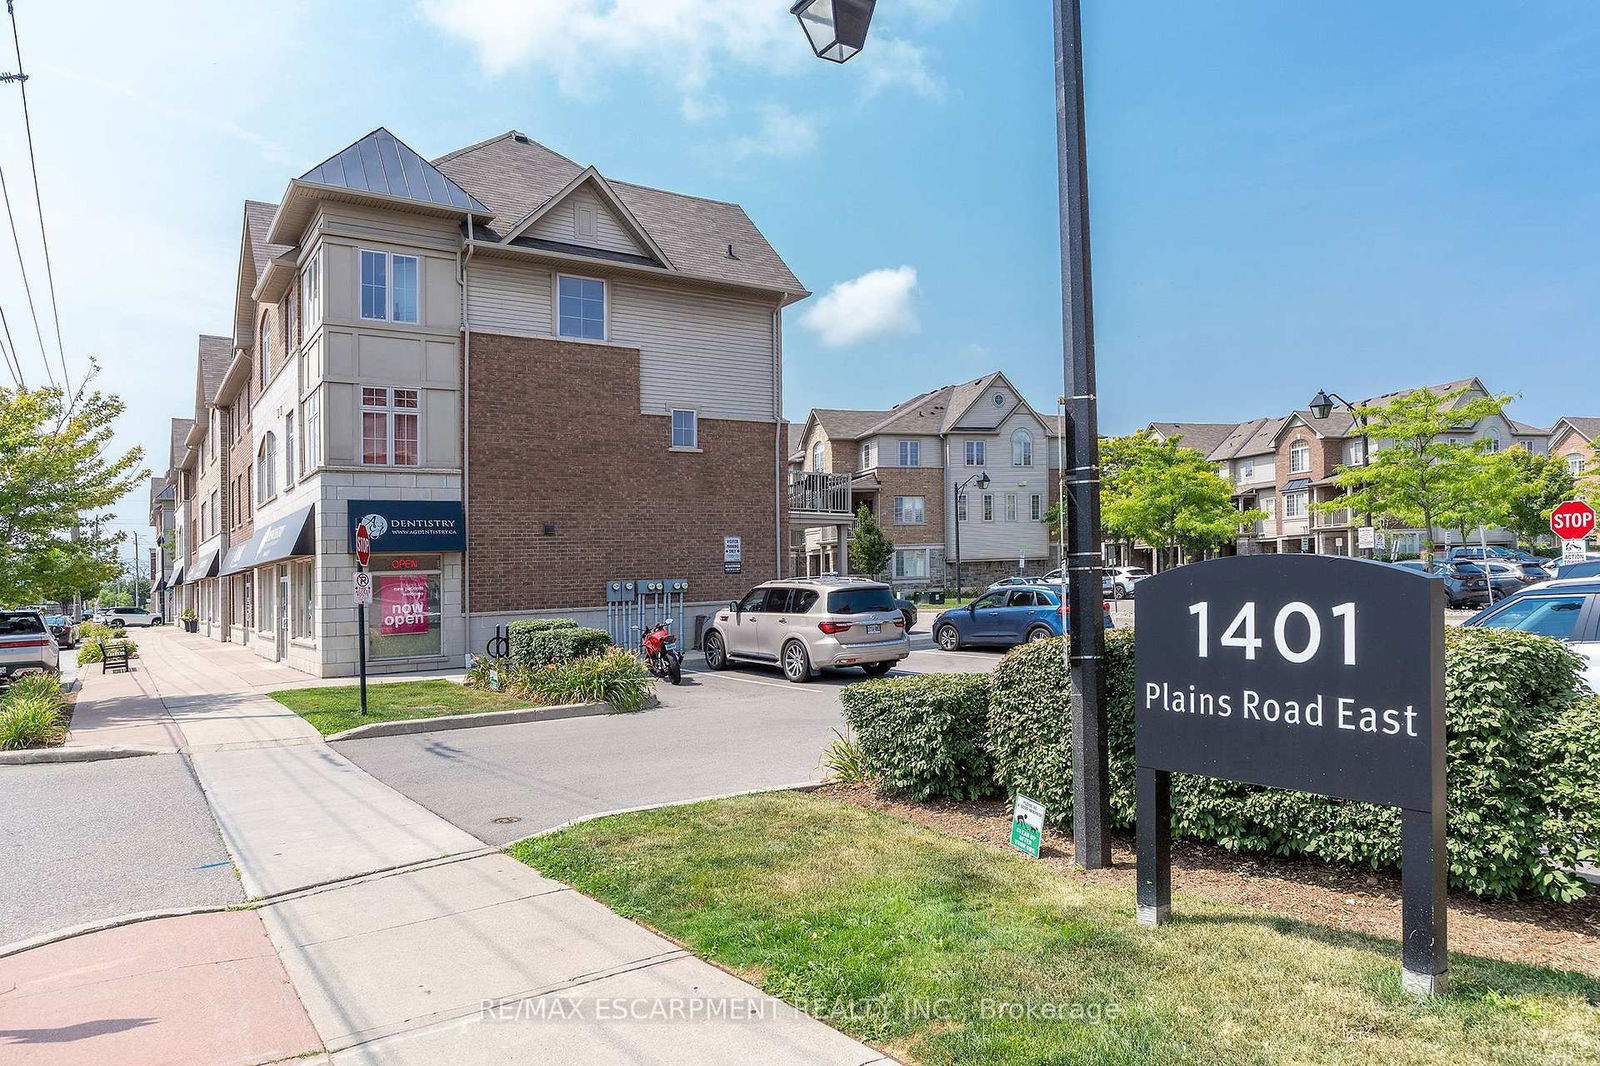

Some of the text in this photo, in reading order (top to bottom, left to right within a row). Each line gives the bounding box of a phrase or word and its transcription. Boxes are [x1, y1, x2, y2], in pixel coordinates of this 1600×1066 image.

[391, 519, 456, 528] DENTISTRY
[1554, 512, 1592, 528] STOP
[358, 537, 369, 553] STOP
[391, 559, 419, 569] OPEN
[392, 602, 424, 614] now
[384, 614, 424, 628] open
[1189, 601, 1356, 665] 1401
[1145, 682, 1418, 737] Plains Road East
